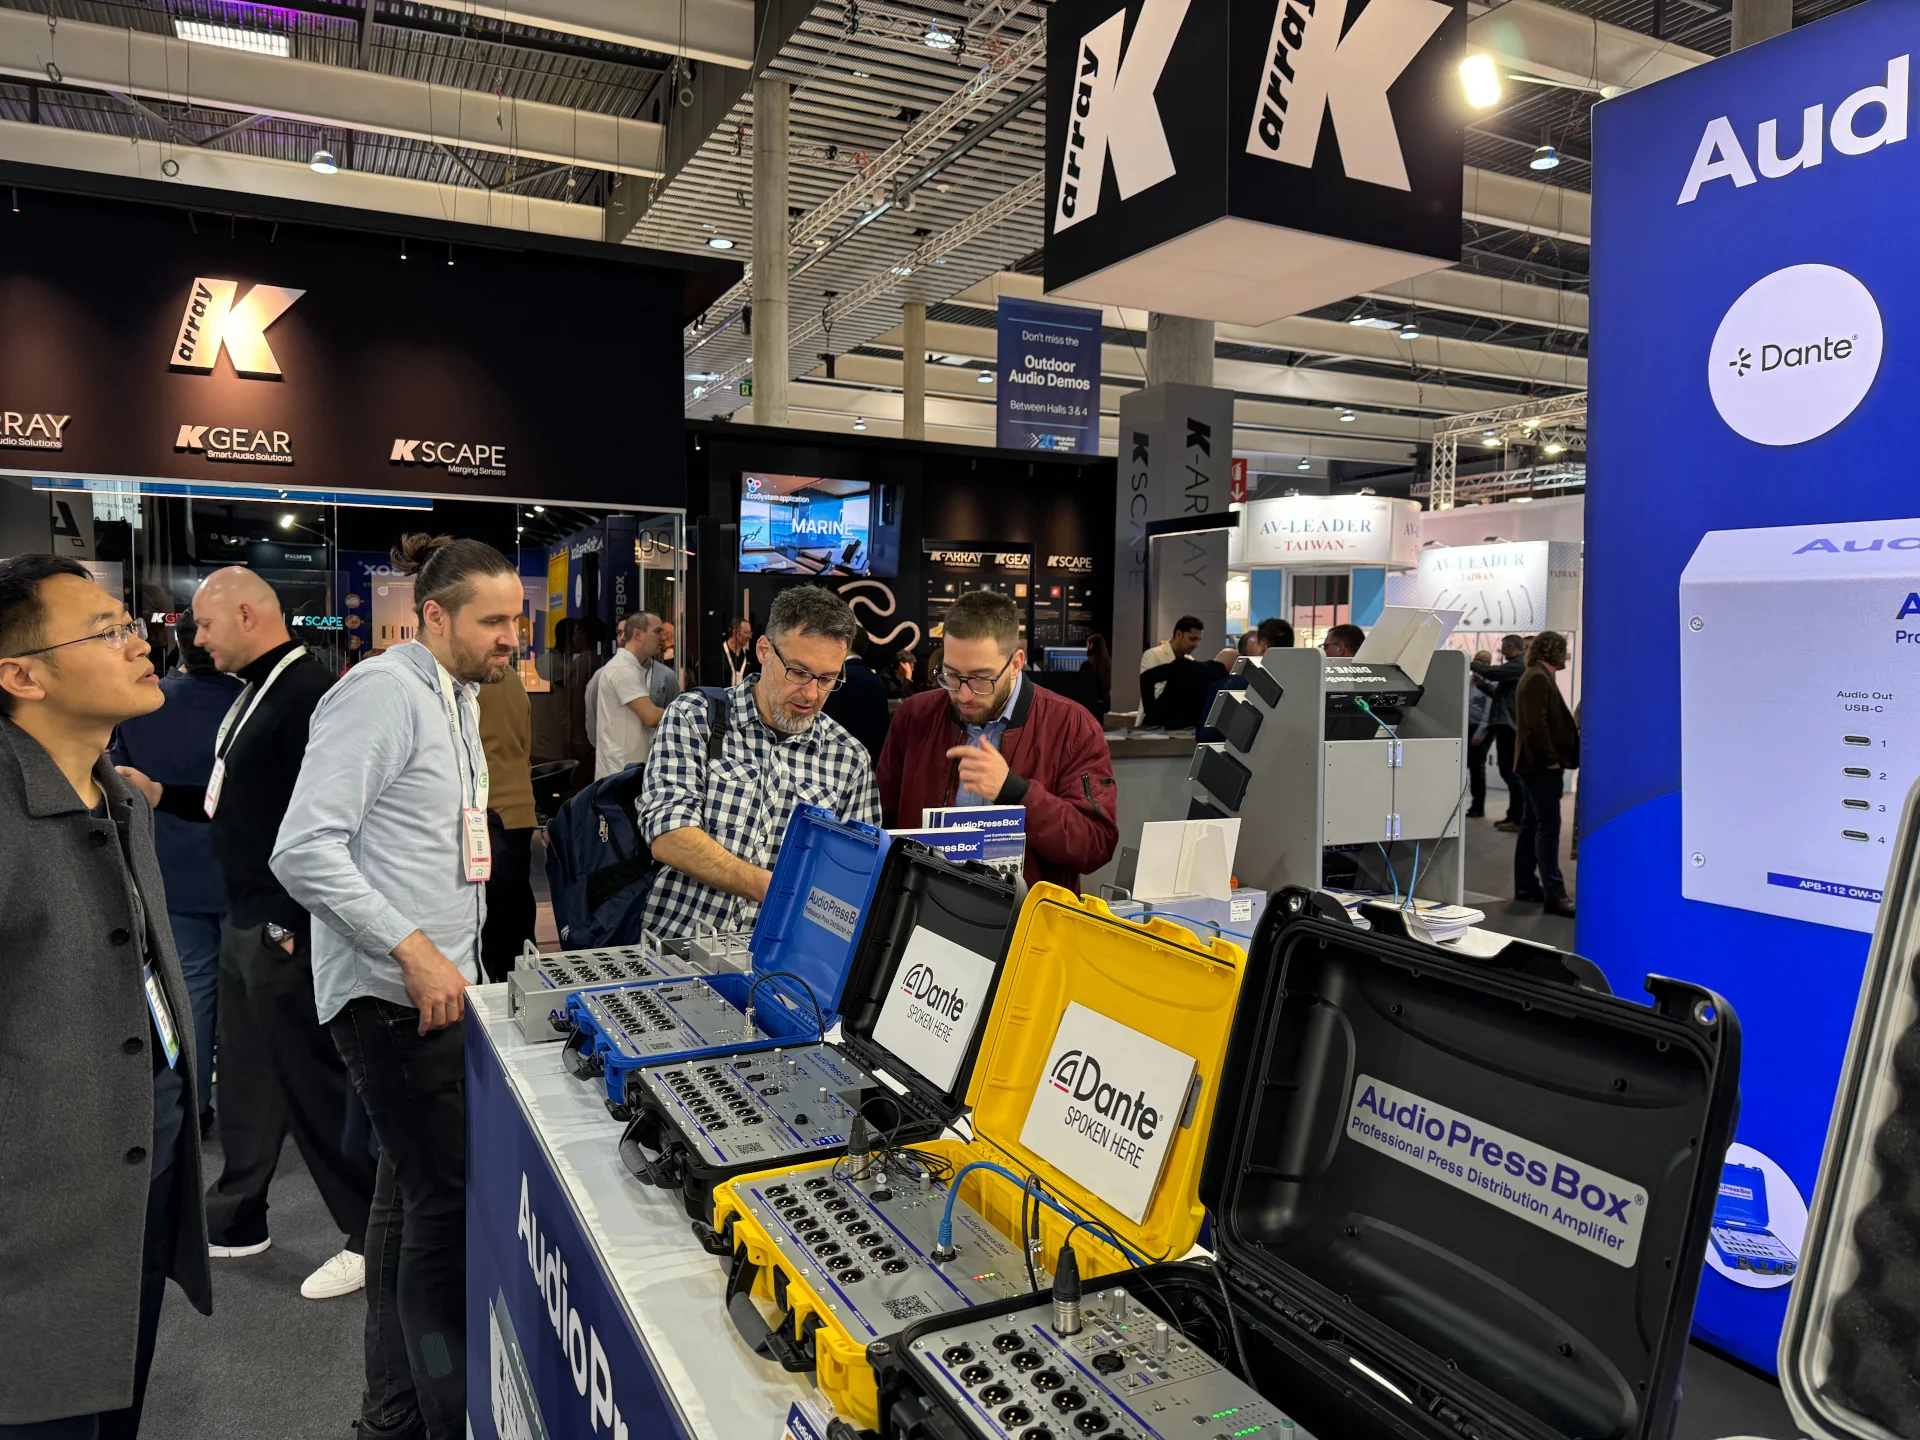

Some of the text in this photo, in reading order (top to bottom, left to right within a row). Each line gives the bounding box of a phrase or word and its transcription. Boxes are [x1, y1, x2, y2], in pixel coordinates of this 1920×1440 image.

[1062, 43, 1100, 219] array
[178, 283, 213, 362] array
[1022, 330, 1079, 346] Don't miss the
[1024, 355, 1076, 373] Outdoor
[1008, 369, 1090, 390] Audio Demos
[1010, 400, 1088, 416] Between Halls 3 & 4
[18, 438, 62, 448] Solutions
[208, 449, 292, 462] Smart Audio Solutions
[448, 465, 506, 476] Merging Senses
[791, 518, 854, 536] MARINE
[1260, 518, 1372, 535] AV-LEADER
[1284, 539, 1345, 552] TAIWAN
[1335, 666, 1372, 674] DRIVE
[1836, 690, 1893, 700] Audio Out
[1844, 704, 1884, 713] USB-C
[1881, 740, 1887, 748] 1
[1879, 772, 1887, 780] 2
[1878, 804, 1886, 812] 3
[1877, 836, 1885, 844] 4
[1799, 880, 1883, 900] APB-112 OW-D
[907, 1003, 953, 1043] SPOKEN HERE
[1064, 1105, 1145, 1170] SPOKEN HERE
[1352, 1115, 1625, 1251] Professional Press Distribution Amplifier
